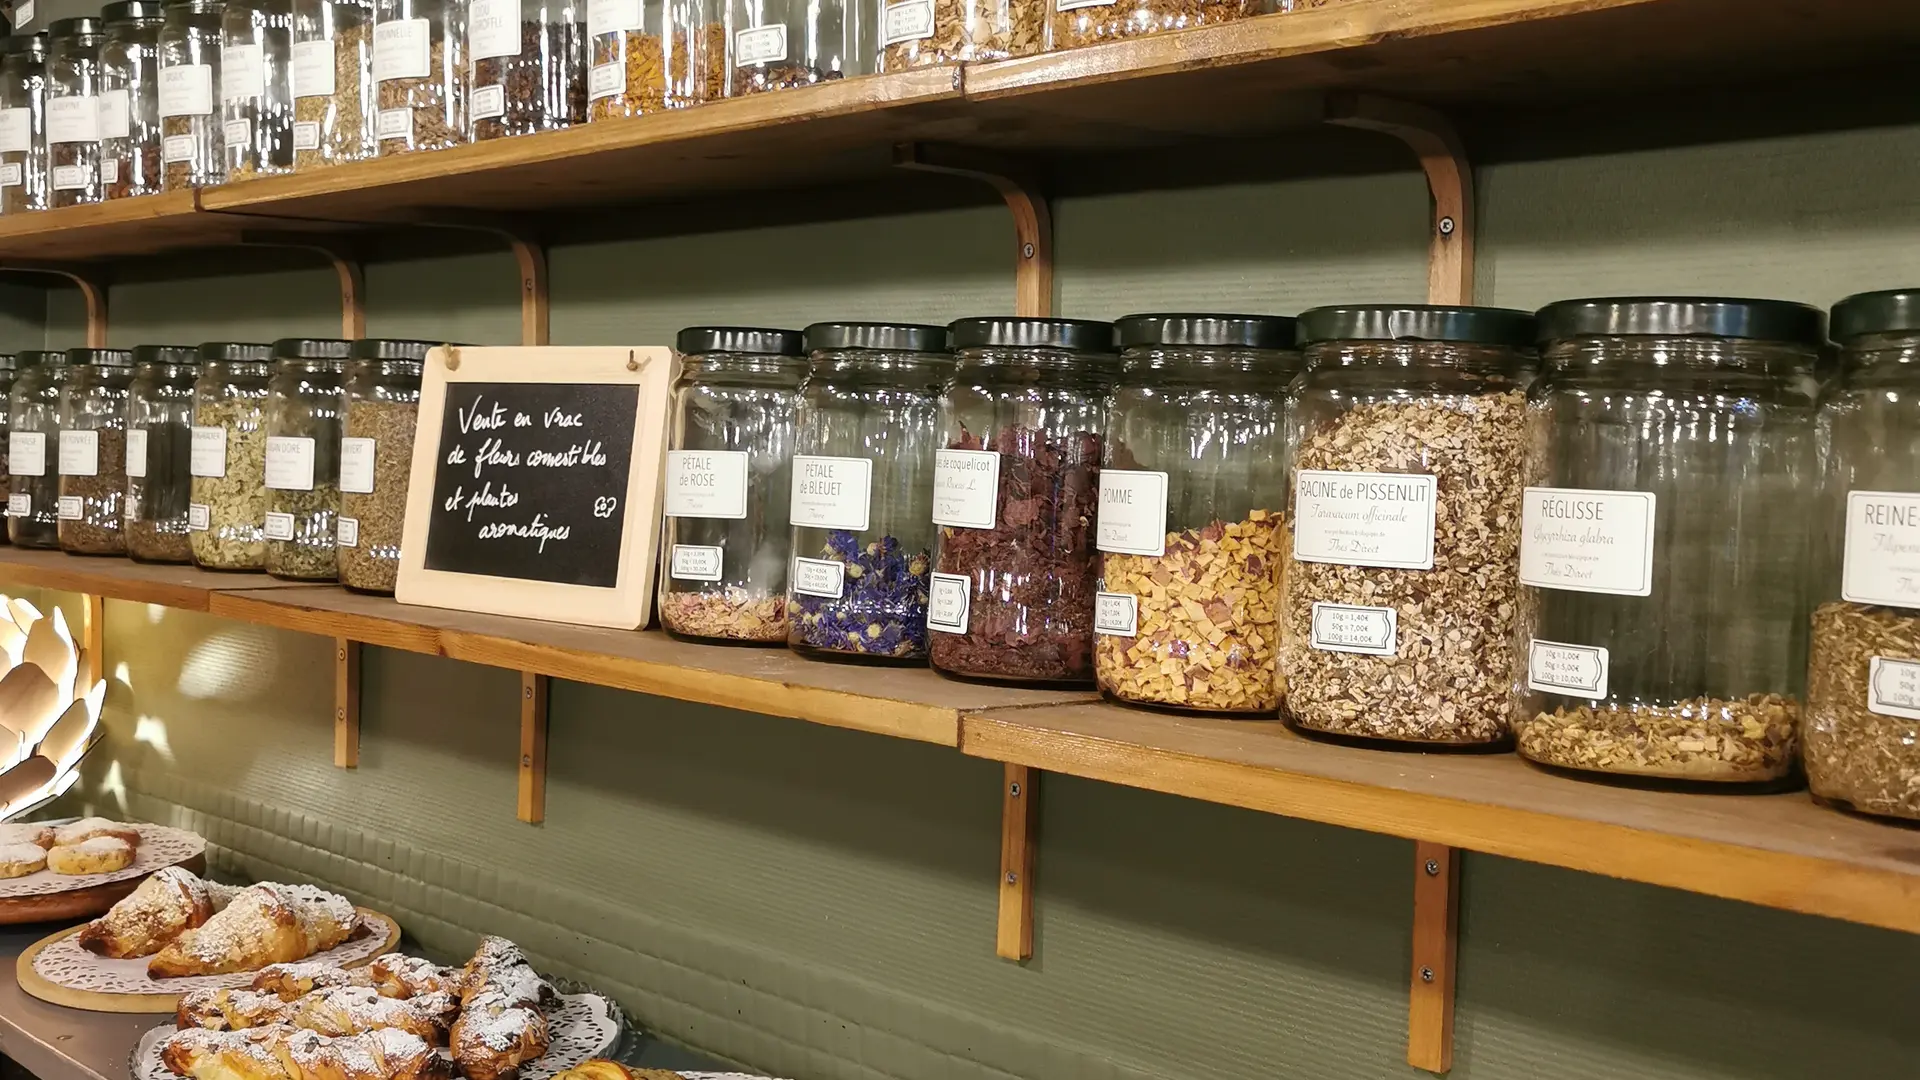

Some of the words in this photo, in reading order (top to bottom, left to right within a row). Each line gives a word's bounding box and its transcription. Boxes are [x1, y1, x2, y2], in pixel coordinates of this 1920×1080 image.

[458, 394, 508, 434] Vente
[513, 412, 532, 428] en
[447, 444, 467, 465] de
[474, 438, 520, 479] fleurs
[526, 439, 607, 467] comestibles
[682, 454, 712, 470] PÉTALE
[950, 458, 990, 472] coquelicot
[805, 461, 834, 478] PÉTALE
[679, 475, 688, 486] de
[690, 473, 715, 487] ROSE
[808, 481, 842, 496] BLEUET
[1104, 488, 1132, 504] POMME
[1300, 480, 1337, 498] RACINE
[1340, 484, 1353, 499] de
[1357, 482, 1428, 502] PISSENLIT
[445, 486, 464, 511] et
[465, 481, 519, 523] plantes
[1541, 495, 1604, 520] RÉGLISSE
[1310, 503, 1360, 520] Taraxacum
[1362, 505, 1408, 524] officinale
[478, 513, 571, 554] aromatiques
[1579, 527, 1614, 547] glabra
[1332, 613, 1343, 621] 10g
[1350, 614, 1369, 622] 1,40€
[1332, 623, 1343, 632] 50g
[1328, 633, 1343, 643] 100g
[1350, 635, 1372, 643] 14,00€
[1546, 650, 1556, 659] 10g
[1562, 652, 1580, 660] 1,00€
[1545, 661, 1555, 670] 50g
[1542, 672, 1555, 682] 100g
[1561, 675, 1583, 684] 10,00€
[1900, 668, 1916, 679] 10g
[1900, 681, 1915, 692] 50g
